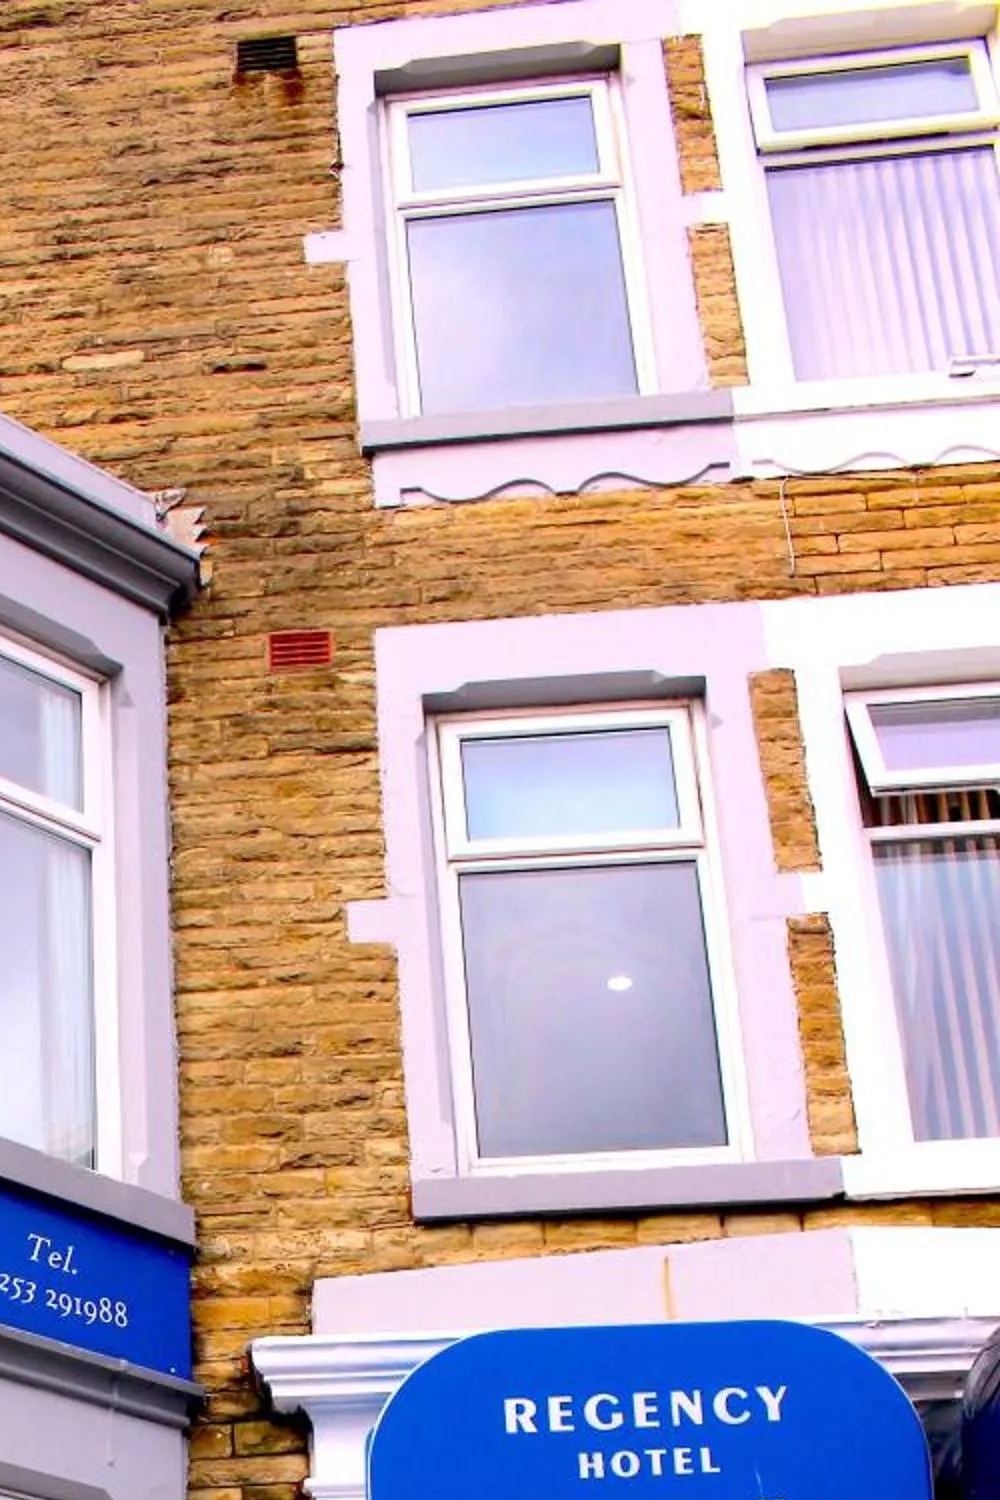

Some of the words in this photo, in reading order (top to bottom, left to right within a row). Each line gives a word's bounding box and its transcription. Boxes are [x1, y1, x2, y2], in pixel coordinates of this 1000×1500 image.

[27, 1232, 78, 1275] Tel.
[44, 1288, 129, 1328] 291988
[503, 1384, 788, 1434] REGENCY
[578, 1446, 722, 1480] HOTEL
